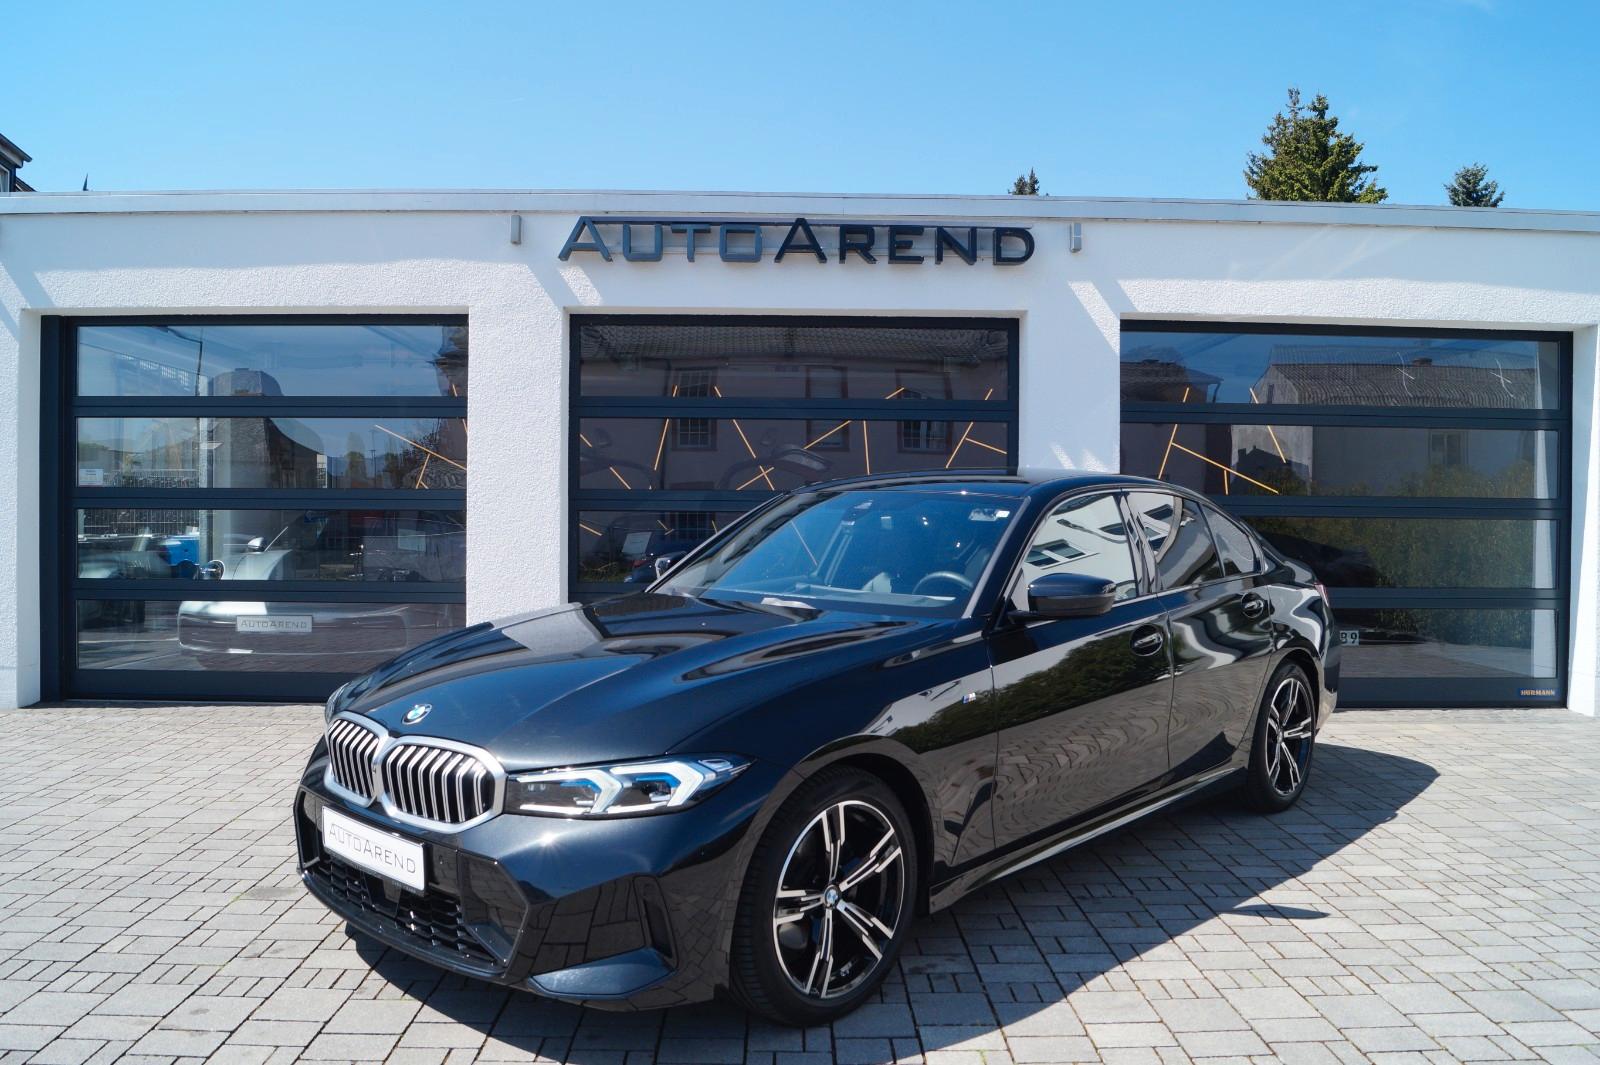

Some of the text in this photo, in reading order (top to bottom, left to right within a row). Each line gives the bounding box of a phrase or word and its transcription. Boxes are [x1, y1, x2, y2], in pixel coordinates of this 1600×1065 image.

[558, 215, 1035, 266] AUTOAREND
[240, 619, 308, 629] AUTOAREND
[328, 823, 417, 874] AUTOAREND
